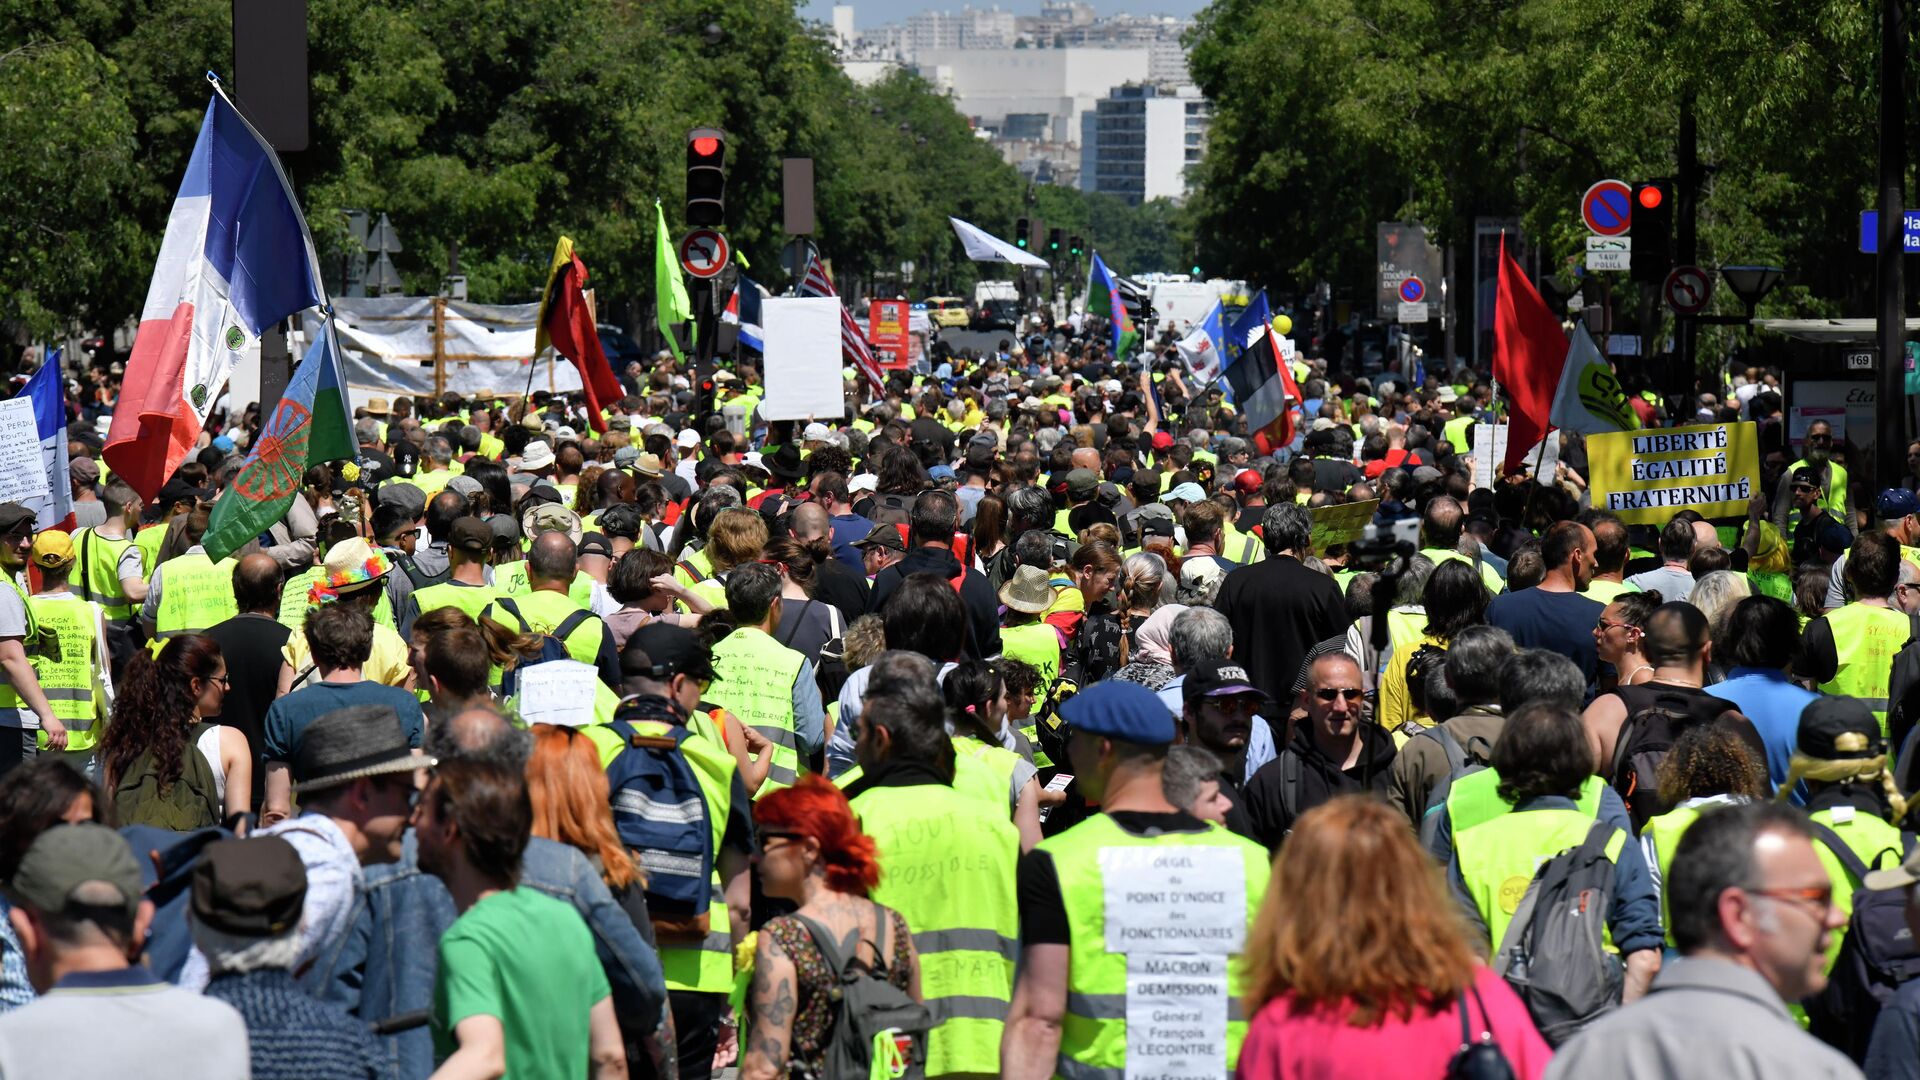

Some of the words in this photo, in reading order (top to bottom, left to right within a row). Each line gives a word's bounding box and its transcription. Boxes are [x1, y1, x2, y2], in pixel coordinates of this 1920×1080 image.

[1850, 355, 1869, 365] 169
[7, 419, 33, 430] PERDU
[1633, 426, 1727, 454] LIBERTÉ
[1632, 453, 1726, 480] ÉGALITÉ
[1609, 477, 1749, 510] FRATERNITÉ
[508, 574, 525, 594] Je
[889, 854, 990, 888] POSSIBLE
[1126, 892, 1165, 903] POINT
[1170, 892, 1226, 903] D'INDICE
[1120, 927, 1234, 940] FONCTIONNAIRES
[1144, 961, 1211, 973] MACRON
[1137, 983, 1218, 996] DEMISSION
[1152, 1010, 1203, 1022] Général
[1149, 1026, 1205, 1040] François
[1137, 1043, 1216, 1056] LECOINTRE
